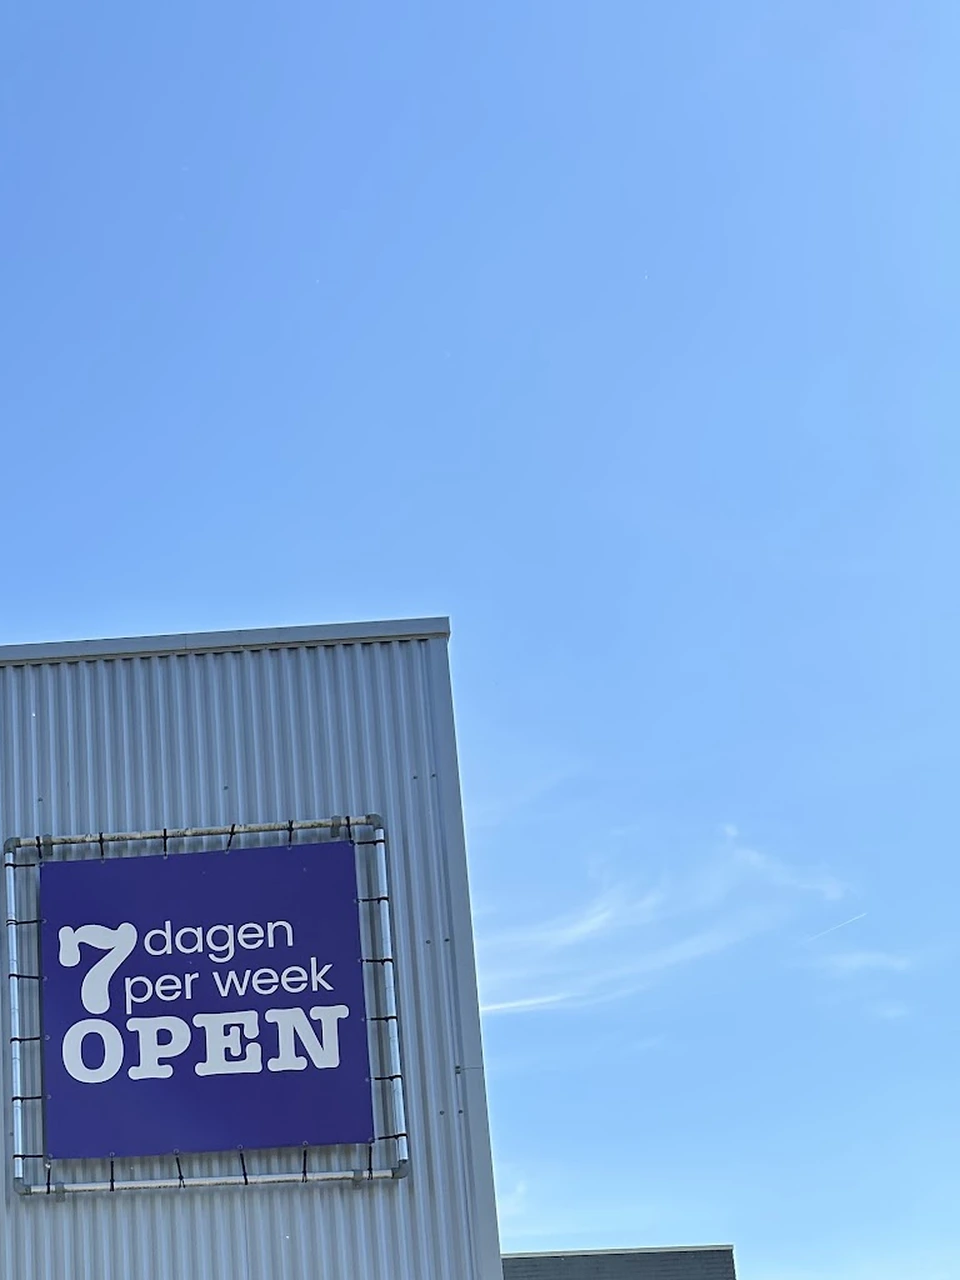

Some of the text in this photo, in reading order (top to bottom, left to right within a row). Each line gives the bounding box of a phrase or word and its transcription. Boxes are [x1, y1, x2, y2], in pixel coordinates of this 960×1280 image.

[58, 920, 294, 1015] 7 dagen
[124, 956, 335, 1015] per week
[61, 1004, 349, 1084] OPEN
